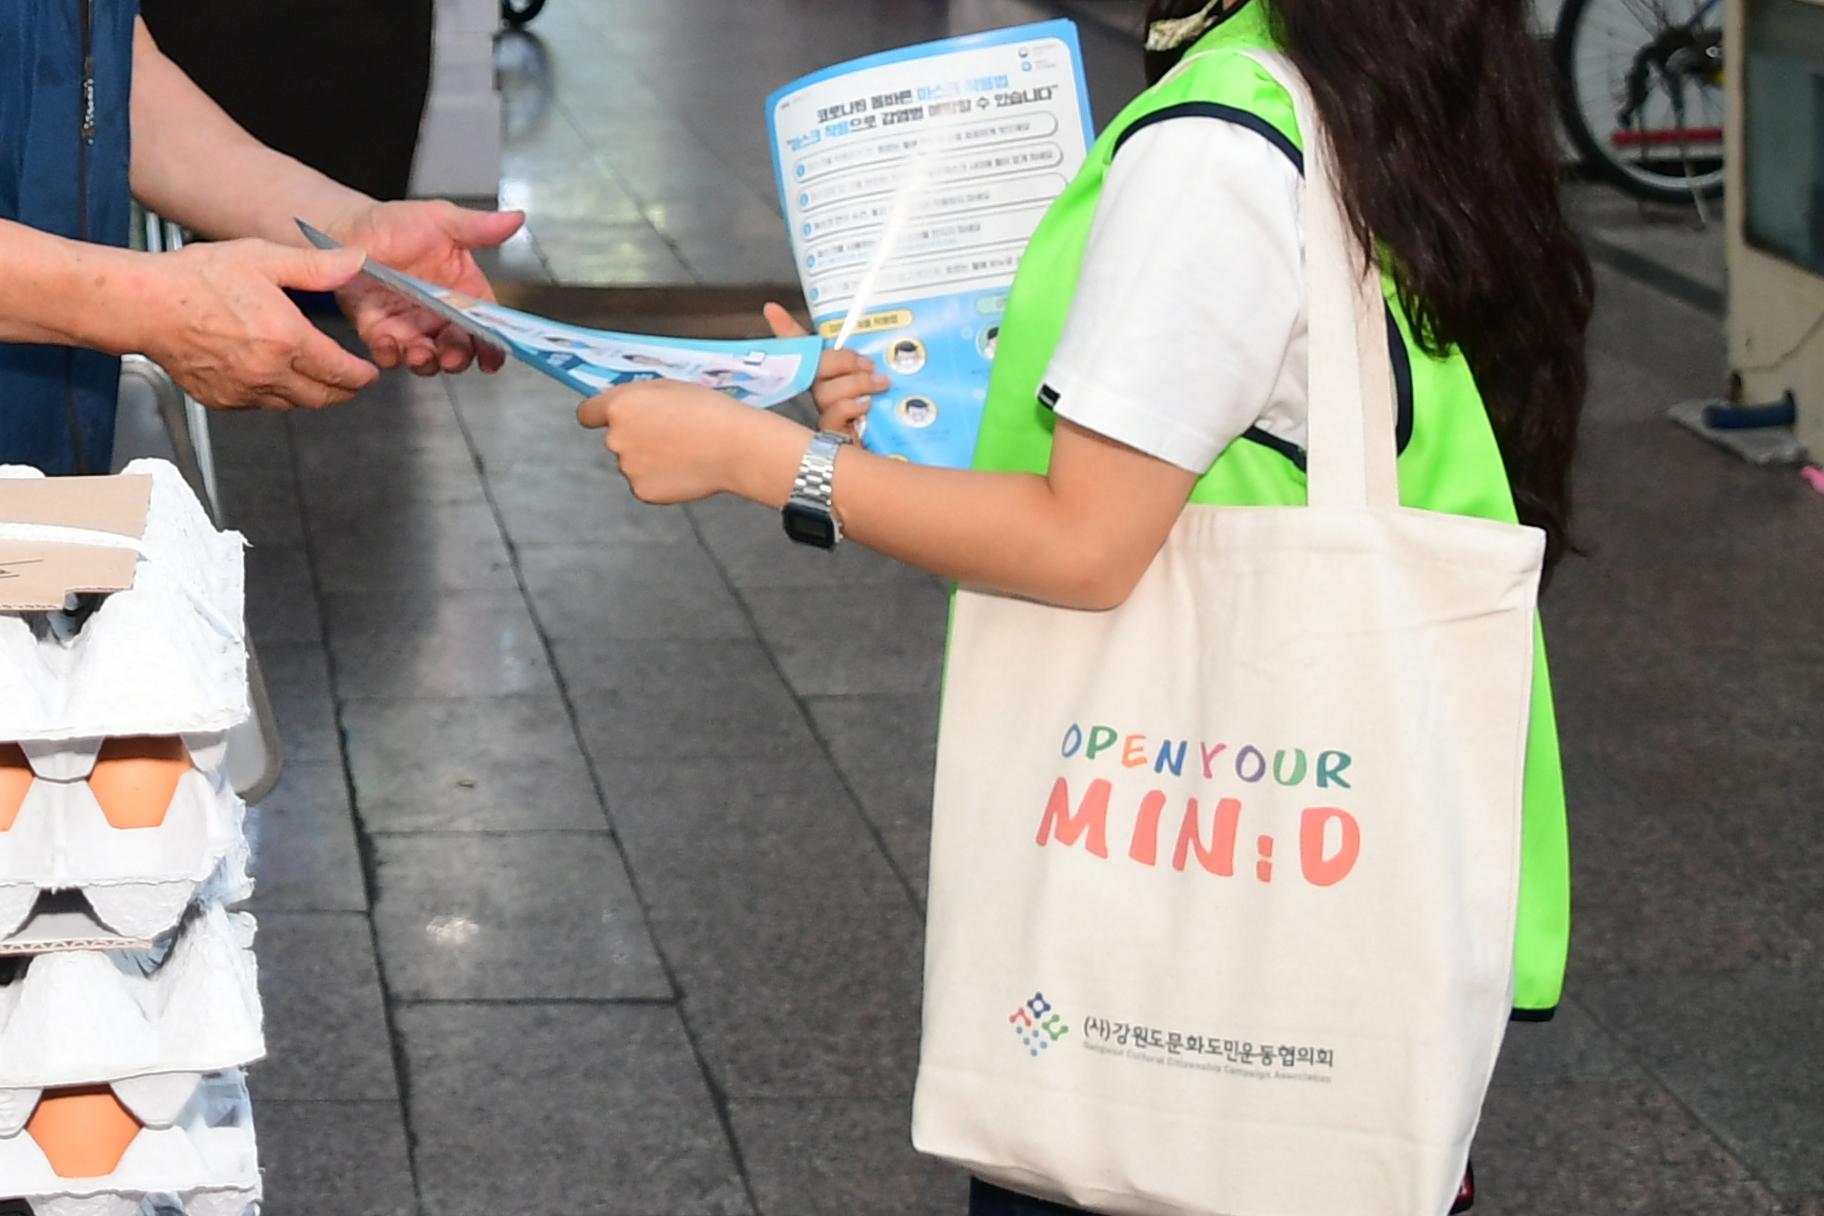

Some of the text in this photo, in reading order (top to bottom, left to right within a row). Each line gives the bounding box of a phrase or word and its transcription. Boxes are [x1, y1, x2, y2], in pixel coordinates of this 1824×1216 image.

[871, 89, 913, 112] 올바른
[976, 96, 990, 111] 수
[1061, 723, 1352, 789] OPEN YOUR
[1083, 1015, 1335, 1068] (사)강원도문화도민운동협의회
